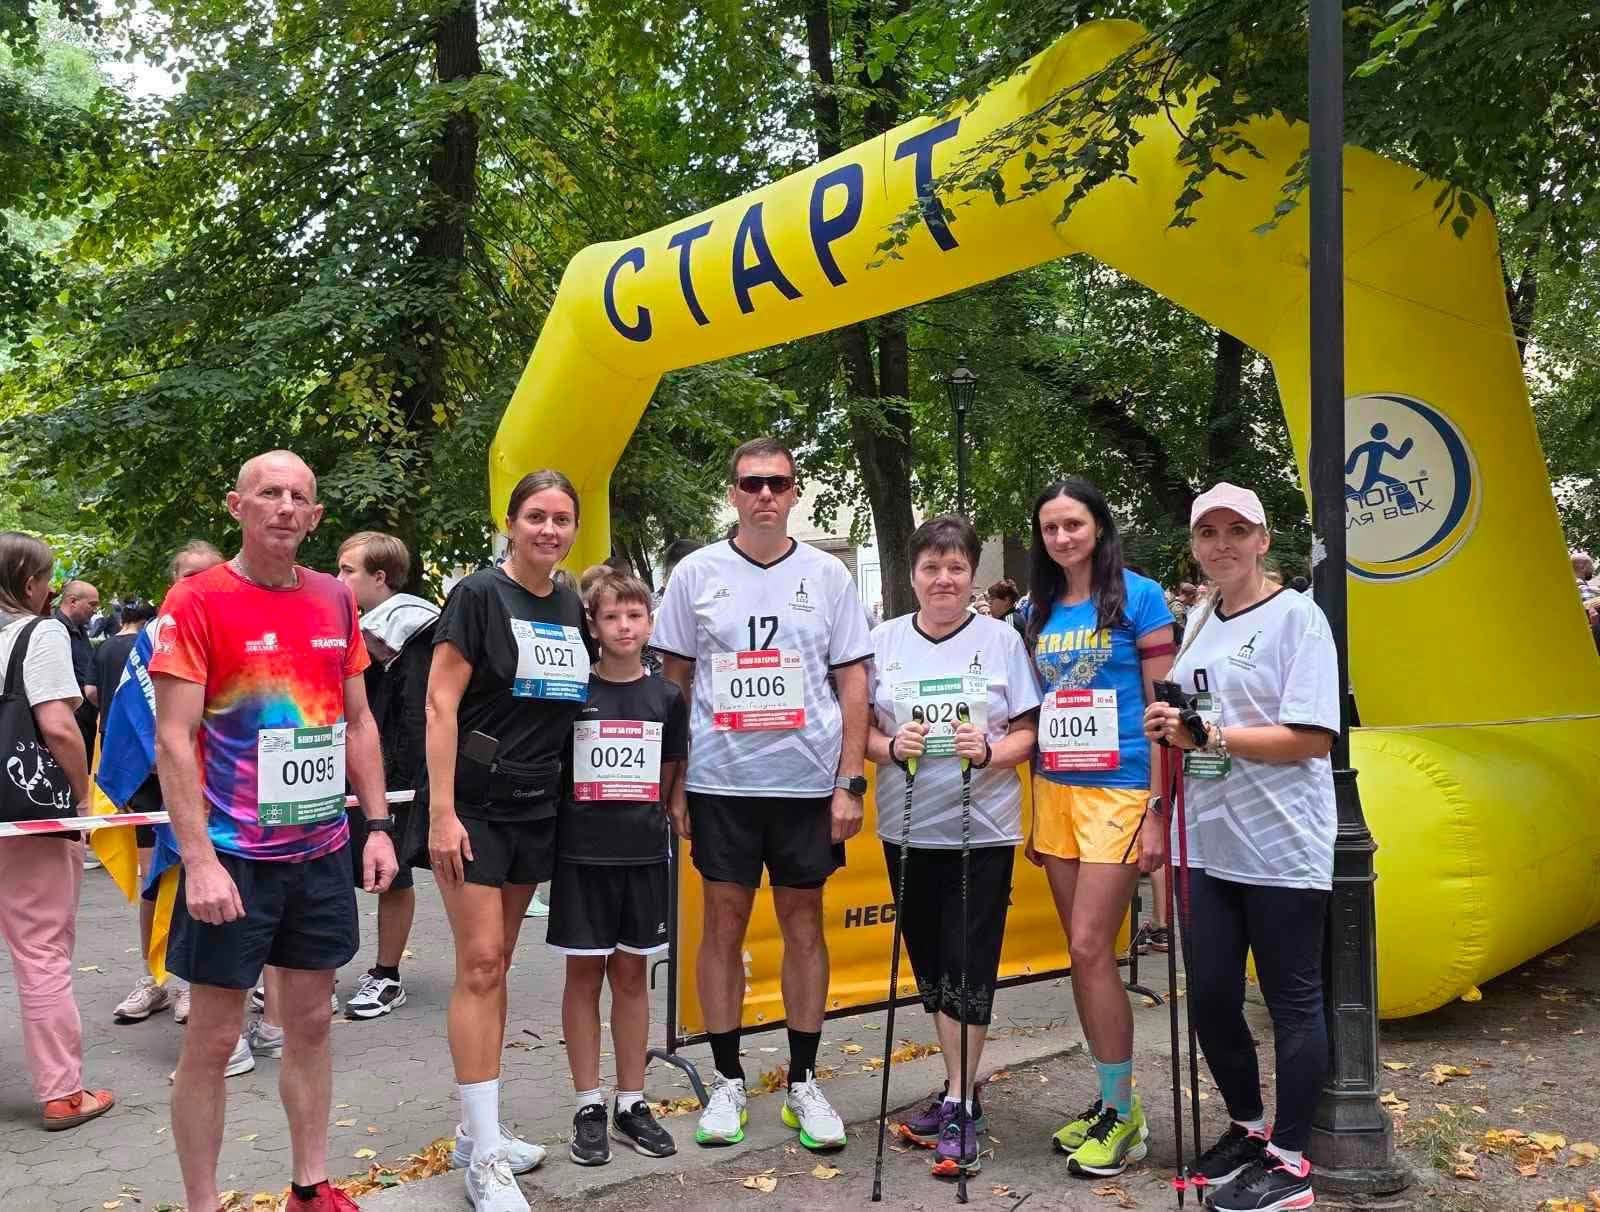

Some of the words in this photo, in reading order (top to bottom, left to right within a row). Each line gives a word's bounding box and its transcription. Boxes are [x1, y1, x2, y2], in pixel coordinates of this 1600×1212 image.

[604, 117, 961, 342] СТАРТ
[1345, 478, 1429, 513] ПОРТ
[1345, 512, 1375, 530] ЛЯ
[748, 615, 779, 651] 12
[1034, 627, 1113, 656] KRAINE
[534, 644, 575, 667] 0127
[730, 676, 785, 699] 0106
[1049, 716, 1098, 739] 0104
[283, 756, 334, 786] 0095
[591, 747, 646, 769] 0024
